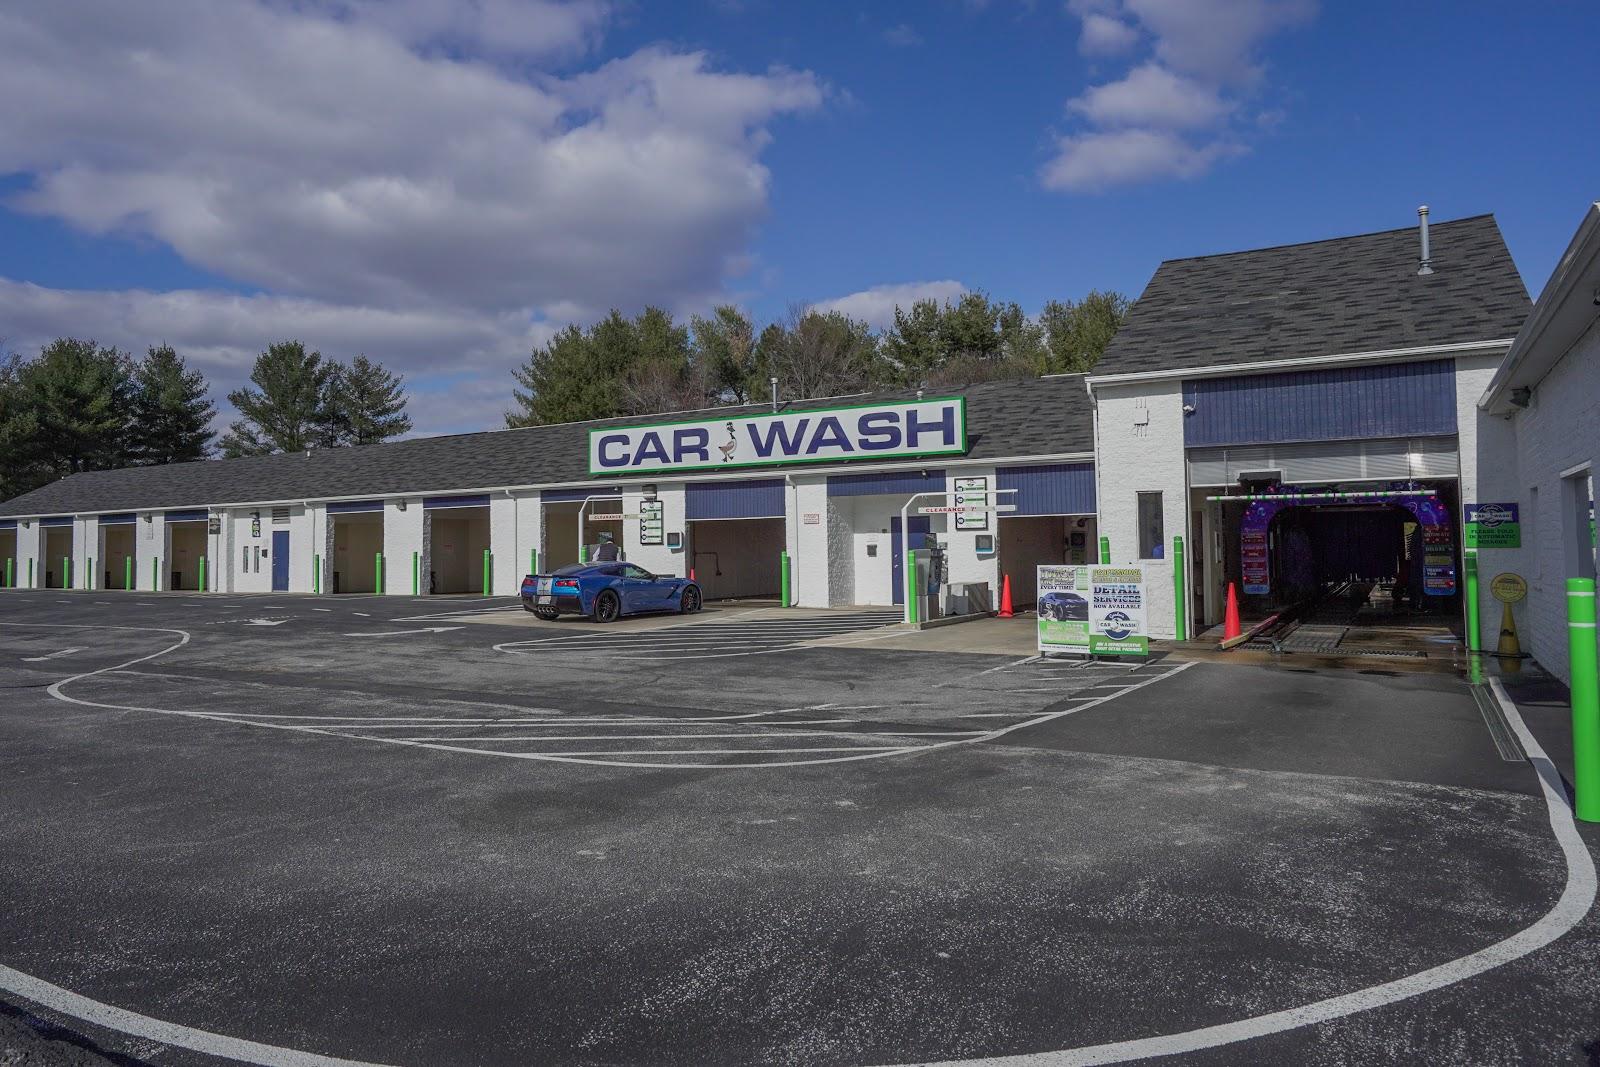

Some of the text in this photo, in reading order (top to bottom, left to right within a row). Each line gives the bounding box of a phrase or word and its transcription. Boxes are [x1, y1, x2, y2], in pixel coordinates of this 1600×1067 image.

[598, 406, 955, 468] CAR WASH
[1093, 585, 1140, 594] DETAIL
